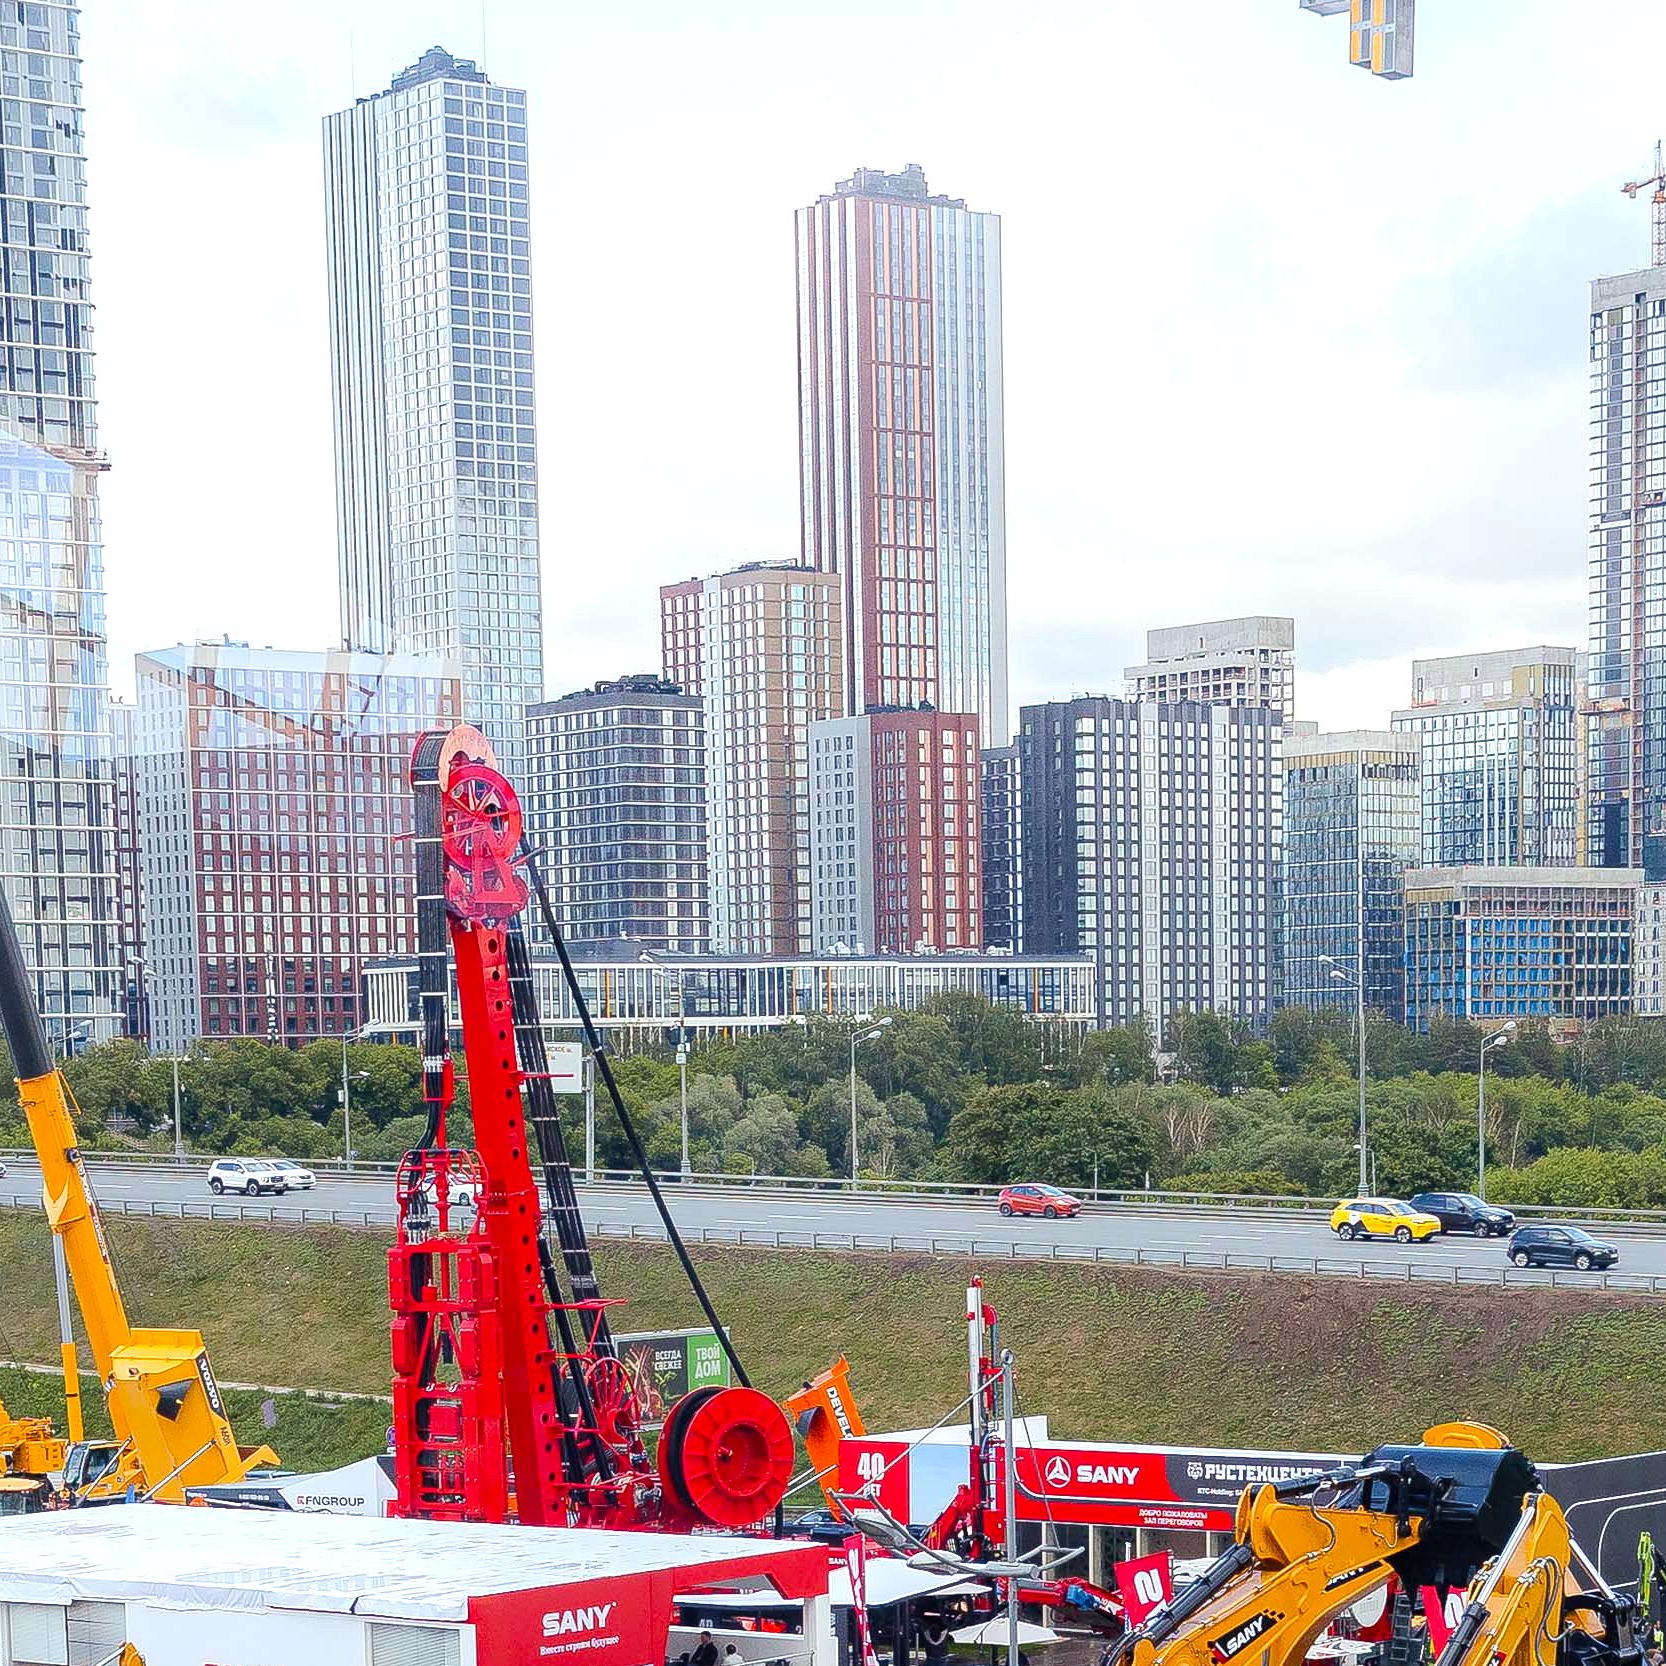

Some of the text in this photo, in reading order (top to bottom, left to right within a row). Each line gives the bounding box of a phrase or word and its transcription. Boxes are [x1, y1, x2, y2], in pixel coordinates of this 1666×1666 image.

[655, 1349, 681, 1361] ВСЕГДА
[695, 1343, 720, 1361] ТВОЙ
[654, 1360, 682, 1370] СВЕЖЕЕ
[695, 1360, 721, 1379] ДОМ
[200, 1358, 219, 1408] VOLVO
[857, 1453, 884, 1480] 40
[1077, 1465, 1139, 1485] SANY
[1139, 1508, 1161, 1517] ДОБРО
[1157, 1518, 1204, 1527] ПЕРЕГОВОРОВ
[542, 1604, 611, 1637] SANY
[1226, 1615, 1264, 1655] SANY
[540, 1643, 565, 1656] Вместе
